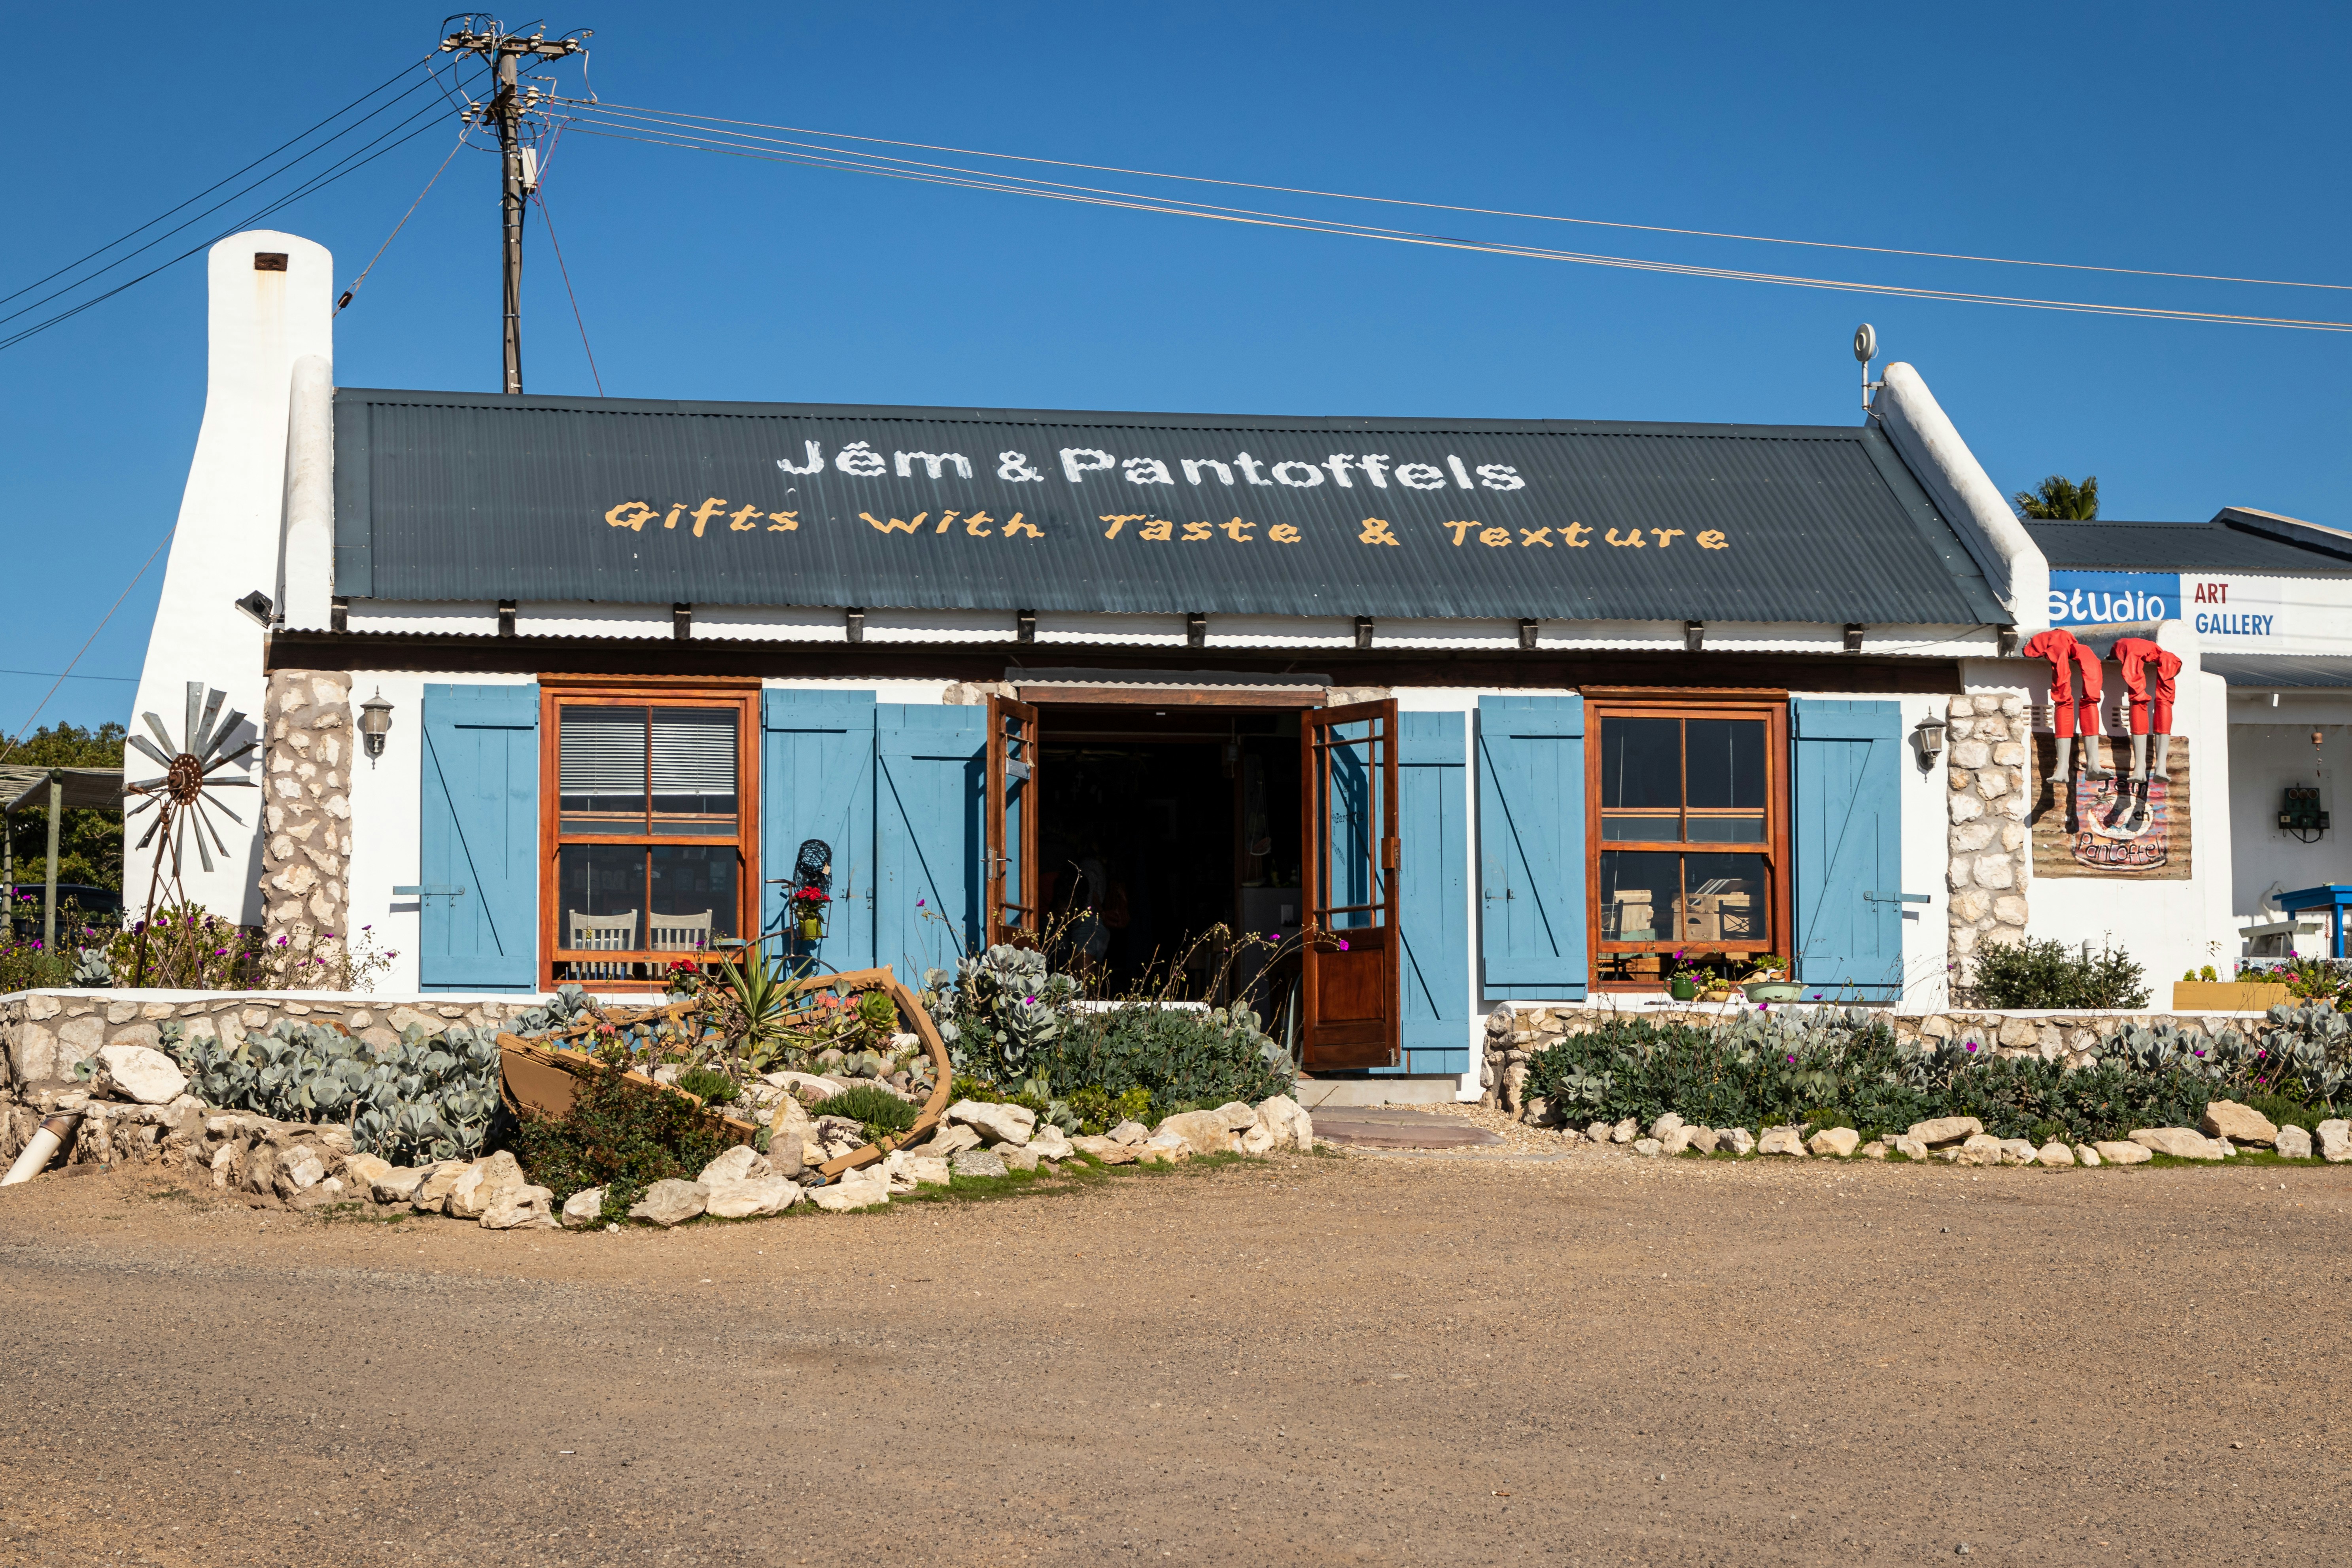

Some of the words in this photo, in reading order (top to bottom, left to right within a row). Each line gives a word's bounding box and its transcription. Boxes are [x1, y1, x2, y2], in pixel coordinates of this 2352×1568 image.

[997, 450, 1045, 482] &
[1059, 447, 1526, 491] Pantoffels
[605, 497, 798, 538] Gifts
[1099, 514, 1302, 544] Taste
[1358, 517, 1400, 546] &
[1443, 520, 1729, 550] Texture
[2194, 583, 2229, 604] ART
[2195, 613, 2274, 636] GALLERY
